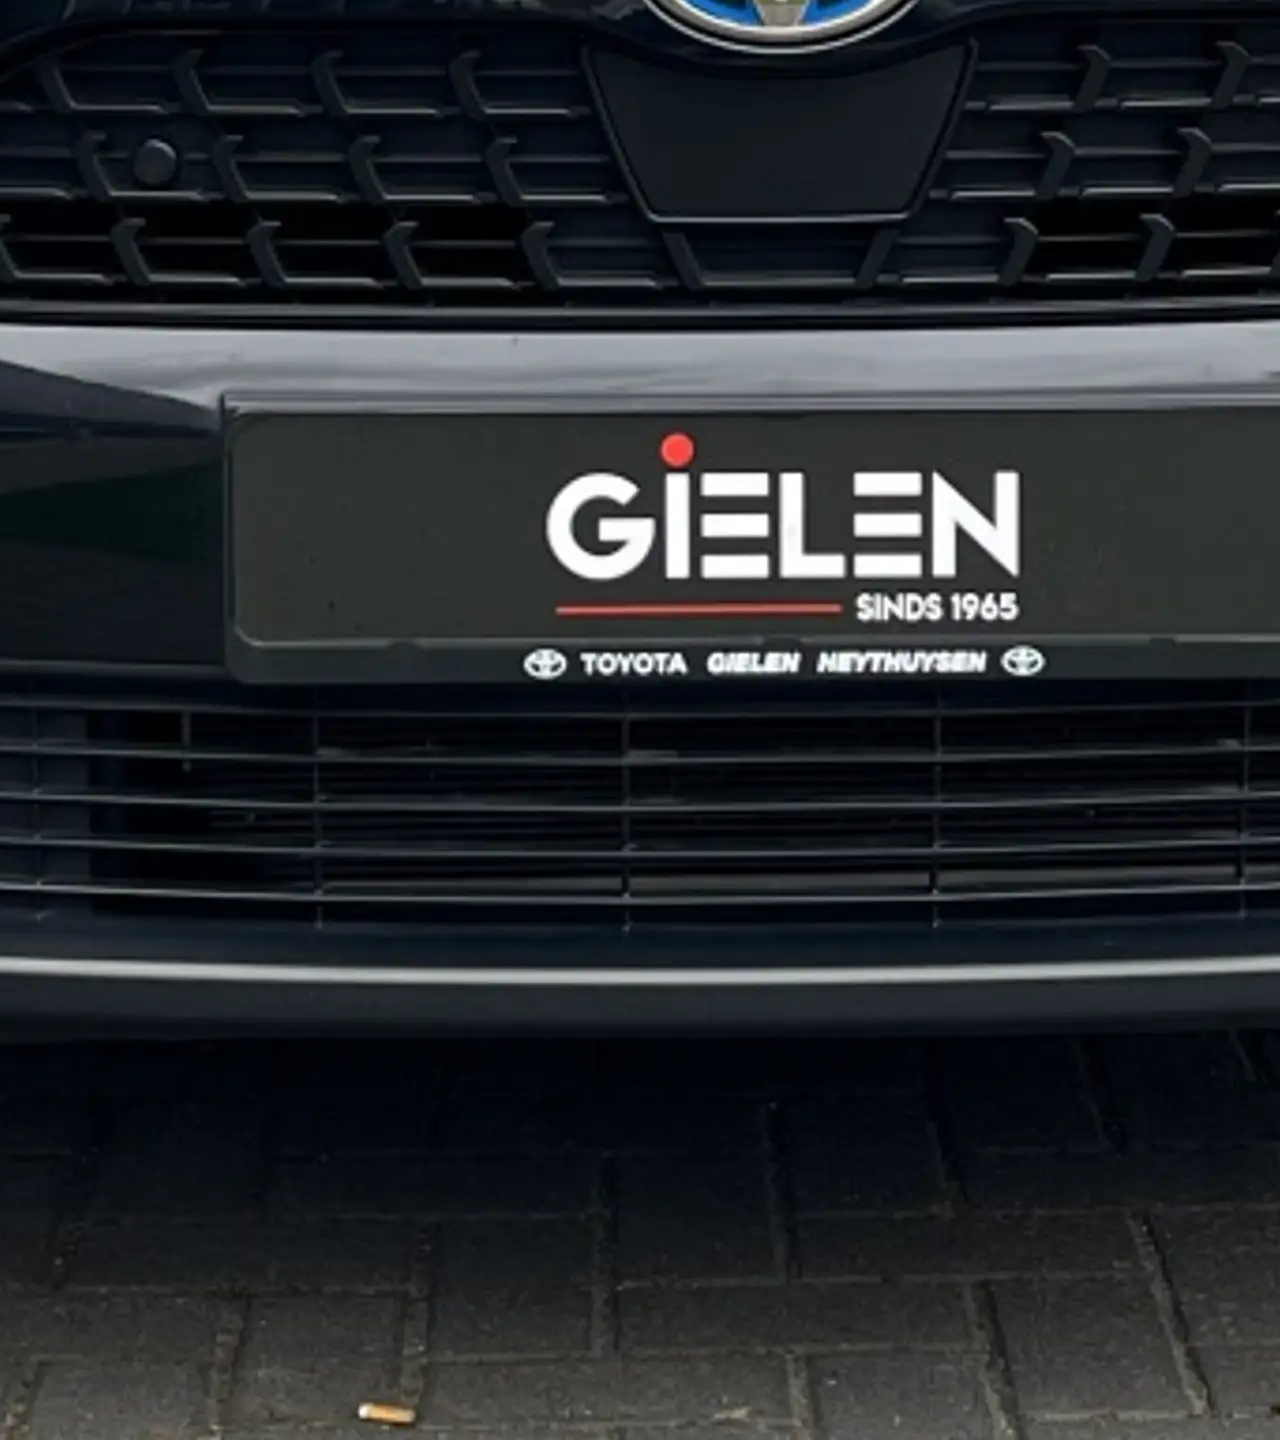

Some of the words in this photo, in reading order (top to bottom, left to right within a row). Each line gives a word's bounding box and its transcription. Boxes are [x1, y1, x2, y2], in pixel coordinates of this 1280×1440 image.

[855, 592, 944, 622] SINDS
[950, 592, 1019, 621] 1965
[579, 652, 689, 675] TOYOTA
[706, 651, 801, 674] GIELEN
